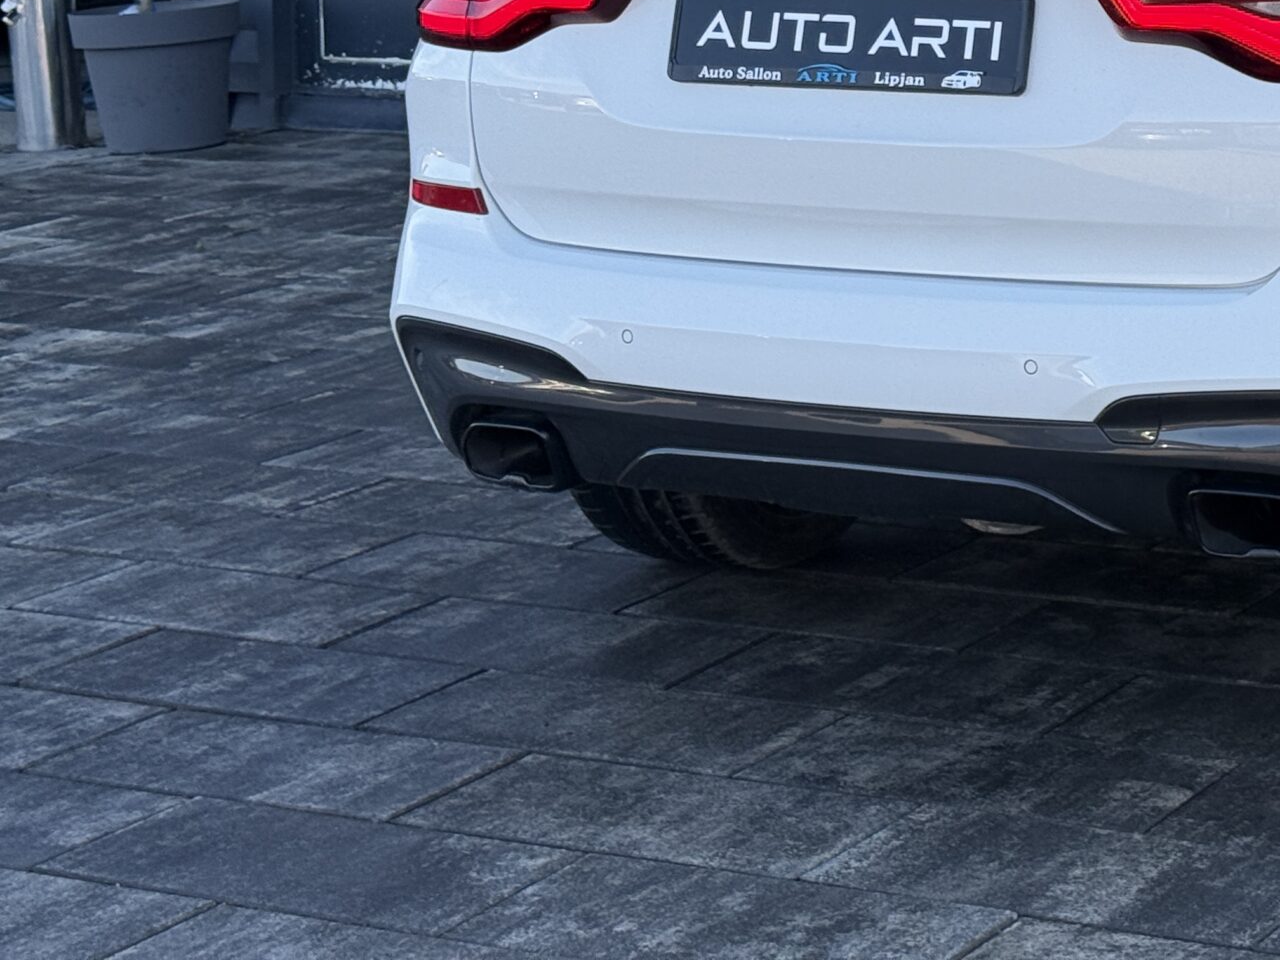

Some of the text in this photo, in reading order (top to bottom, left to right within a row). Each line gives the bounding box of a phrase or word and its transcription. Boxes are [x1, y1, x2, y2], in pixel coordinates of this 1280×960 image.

[696, 10, 1003, 61] AUTO ARTI
[698, 65, 925, 87] Auto Sallon ARTI Lipjan
